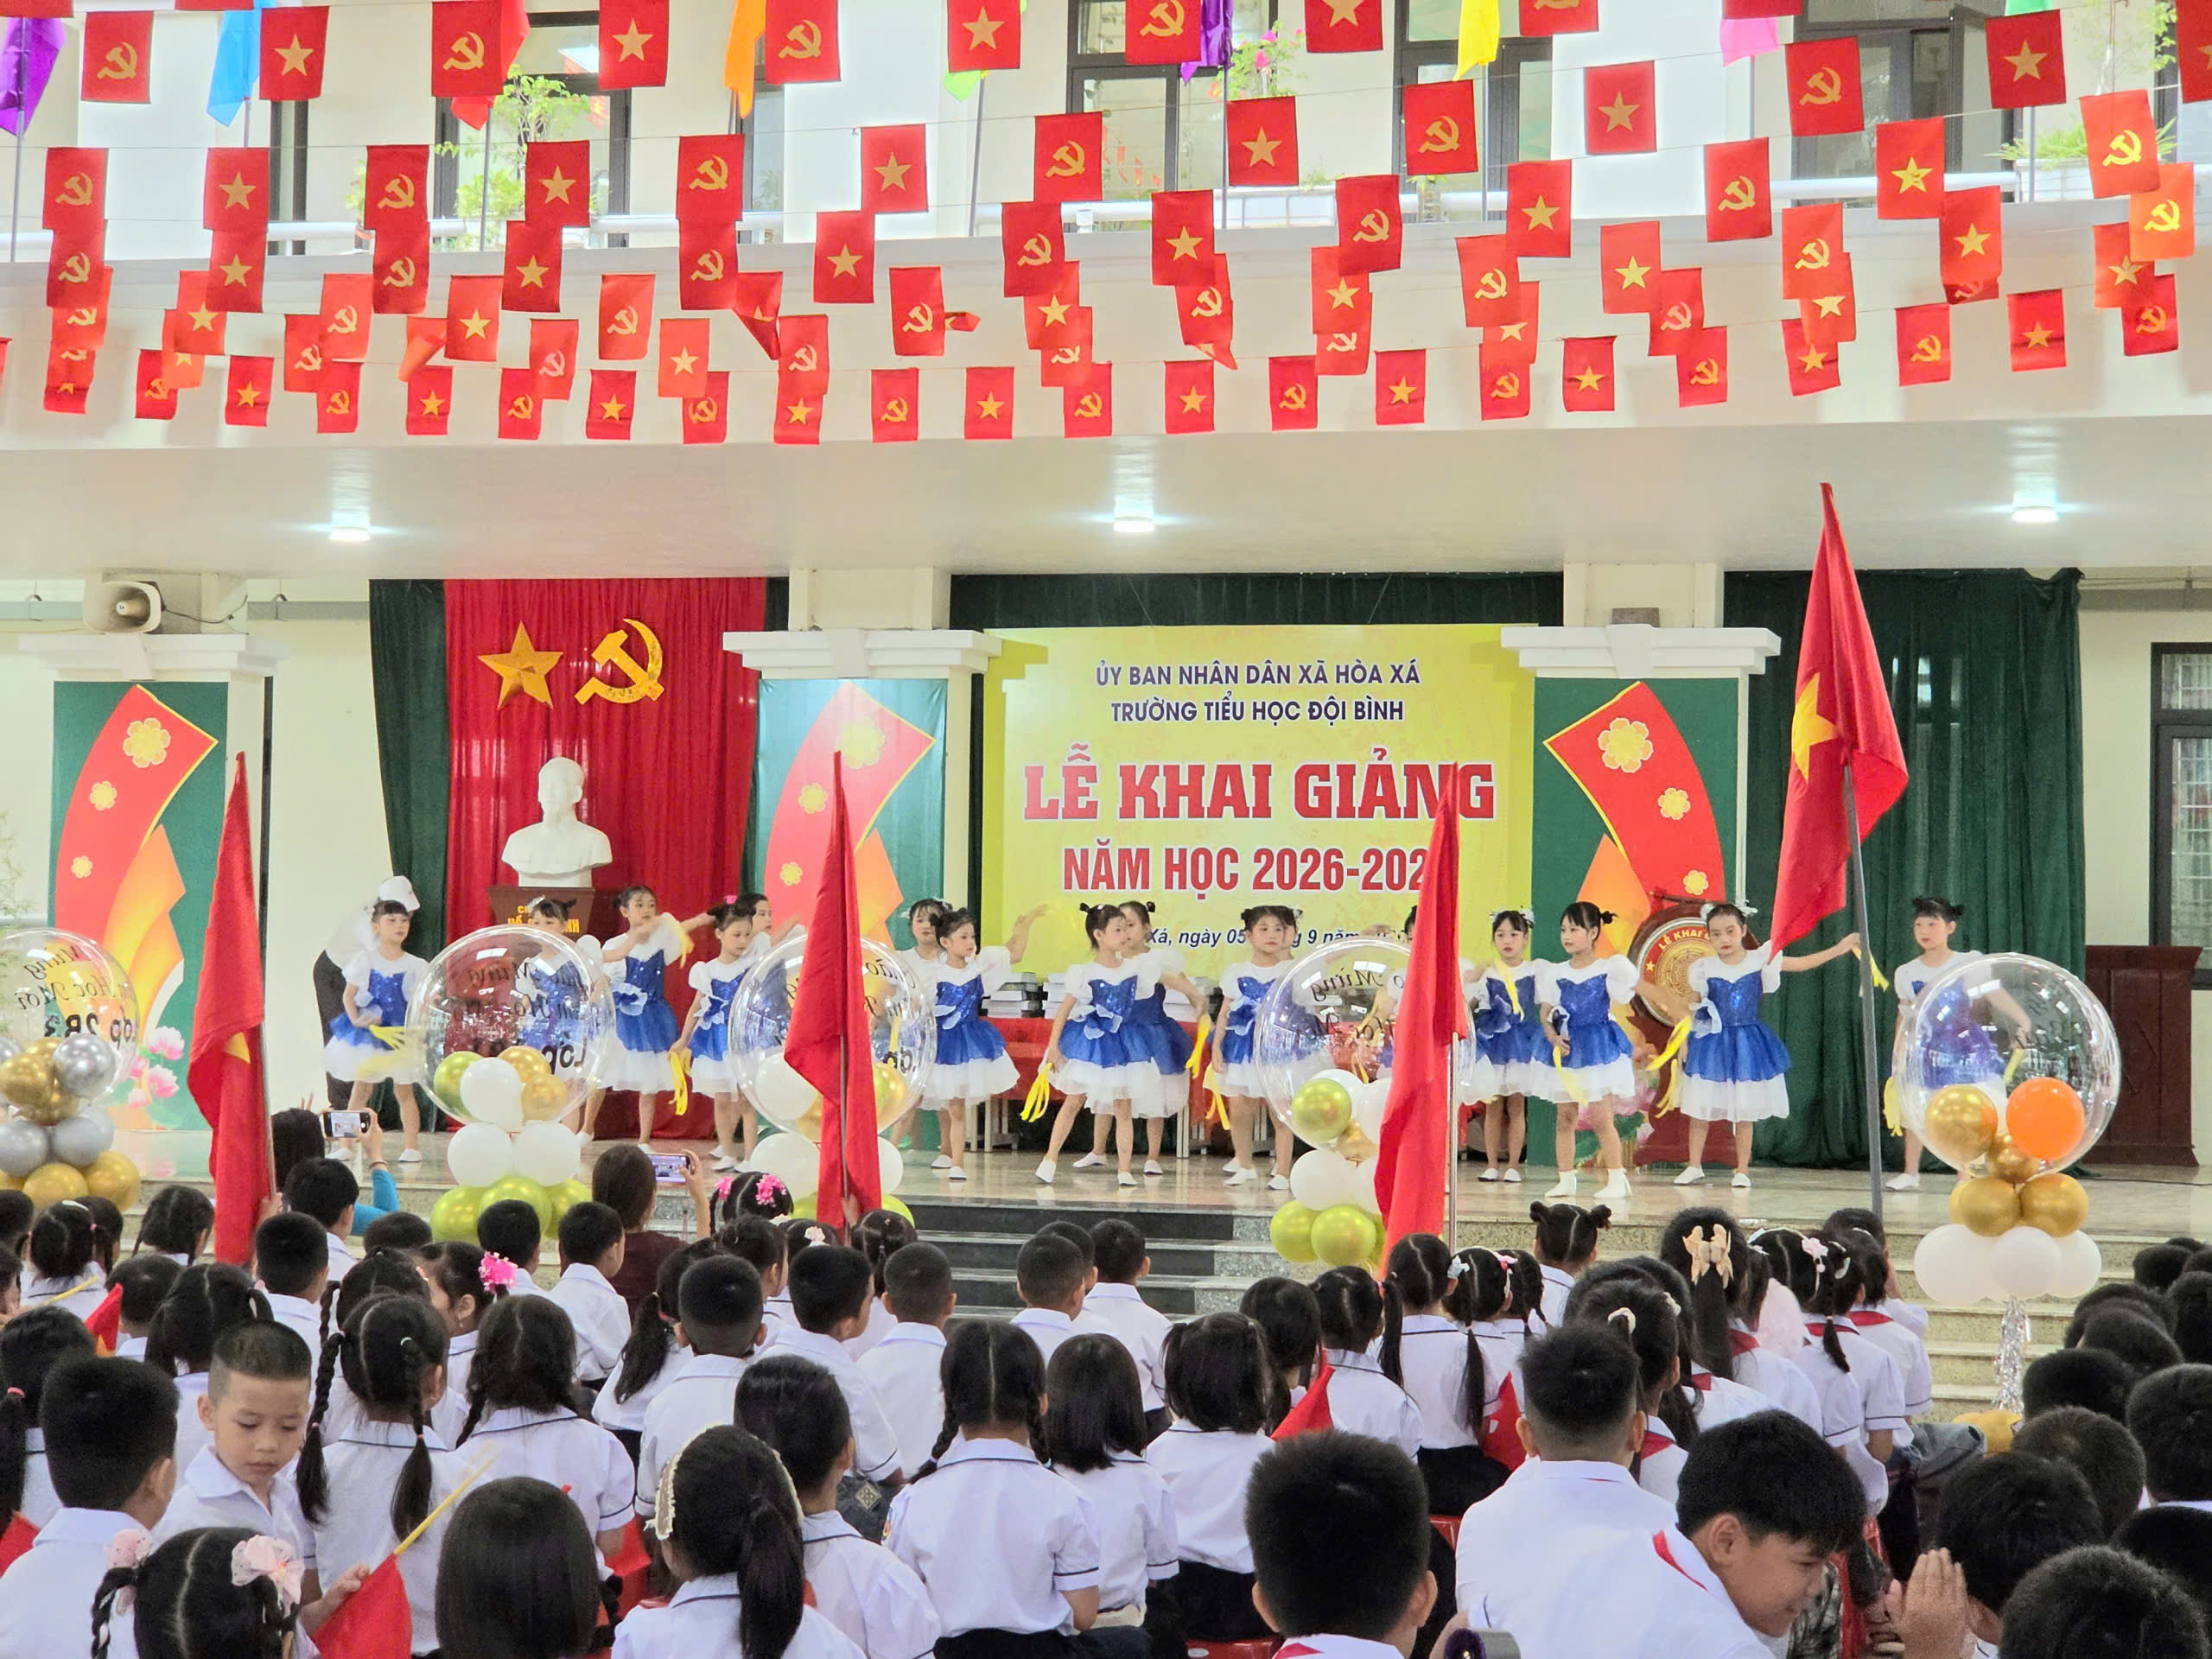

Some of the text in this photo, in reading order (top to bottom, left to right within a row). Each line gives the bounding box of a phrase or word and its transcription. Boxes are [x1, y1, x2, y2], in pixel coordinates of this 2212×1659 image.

[1096, 658, 1421, 685] ỦY BAN NHÂN DÂN XÃ HÒA XÁ
[1111, 690, 1403, 727] TRƯỜNG TIỂU HỌC ĐỘI BÌNH
[1024, 742, 1494, 819] LỄ KHAI GIẢNG
[1064, 839, 1430, 899] NĂM HỌC 2026-202
[1179, 928, 1222, 948] ngày
[1227, 928, 1246, 944] 05
[1308, 929, 1318, 944] 9
[1673, 929, 1702, 941] KHAI
